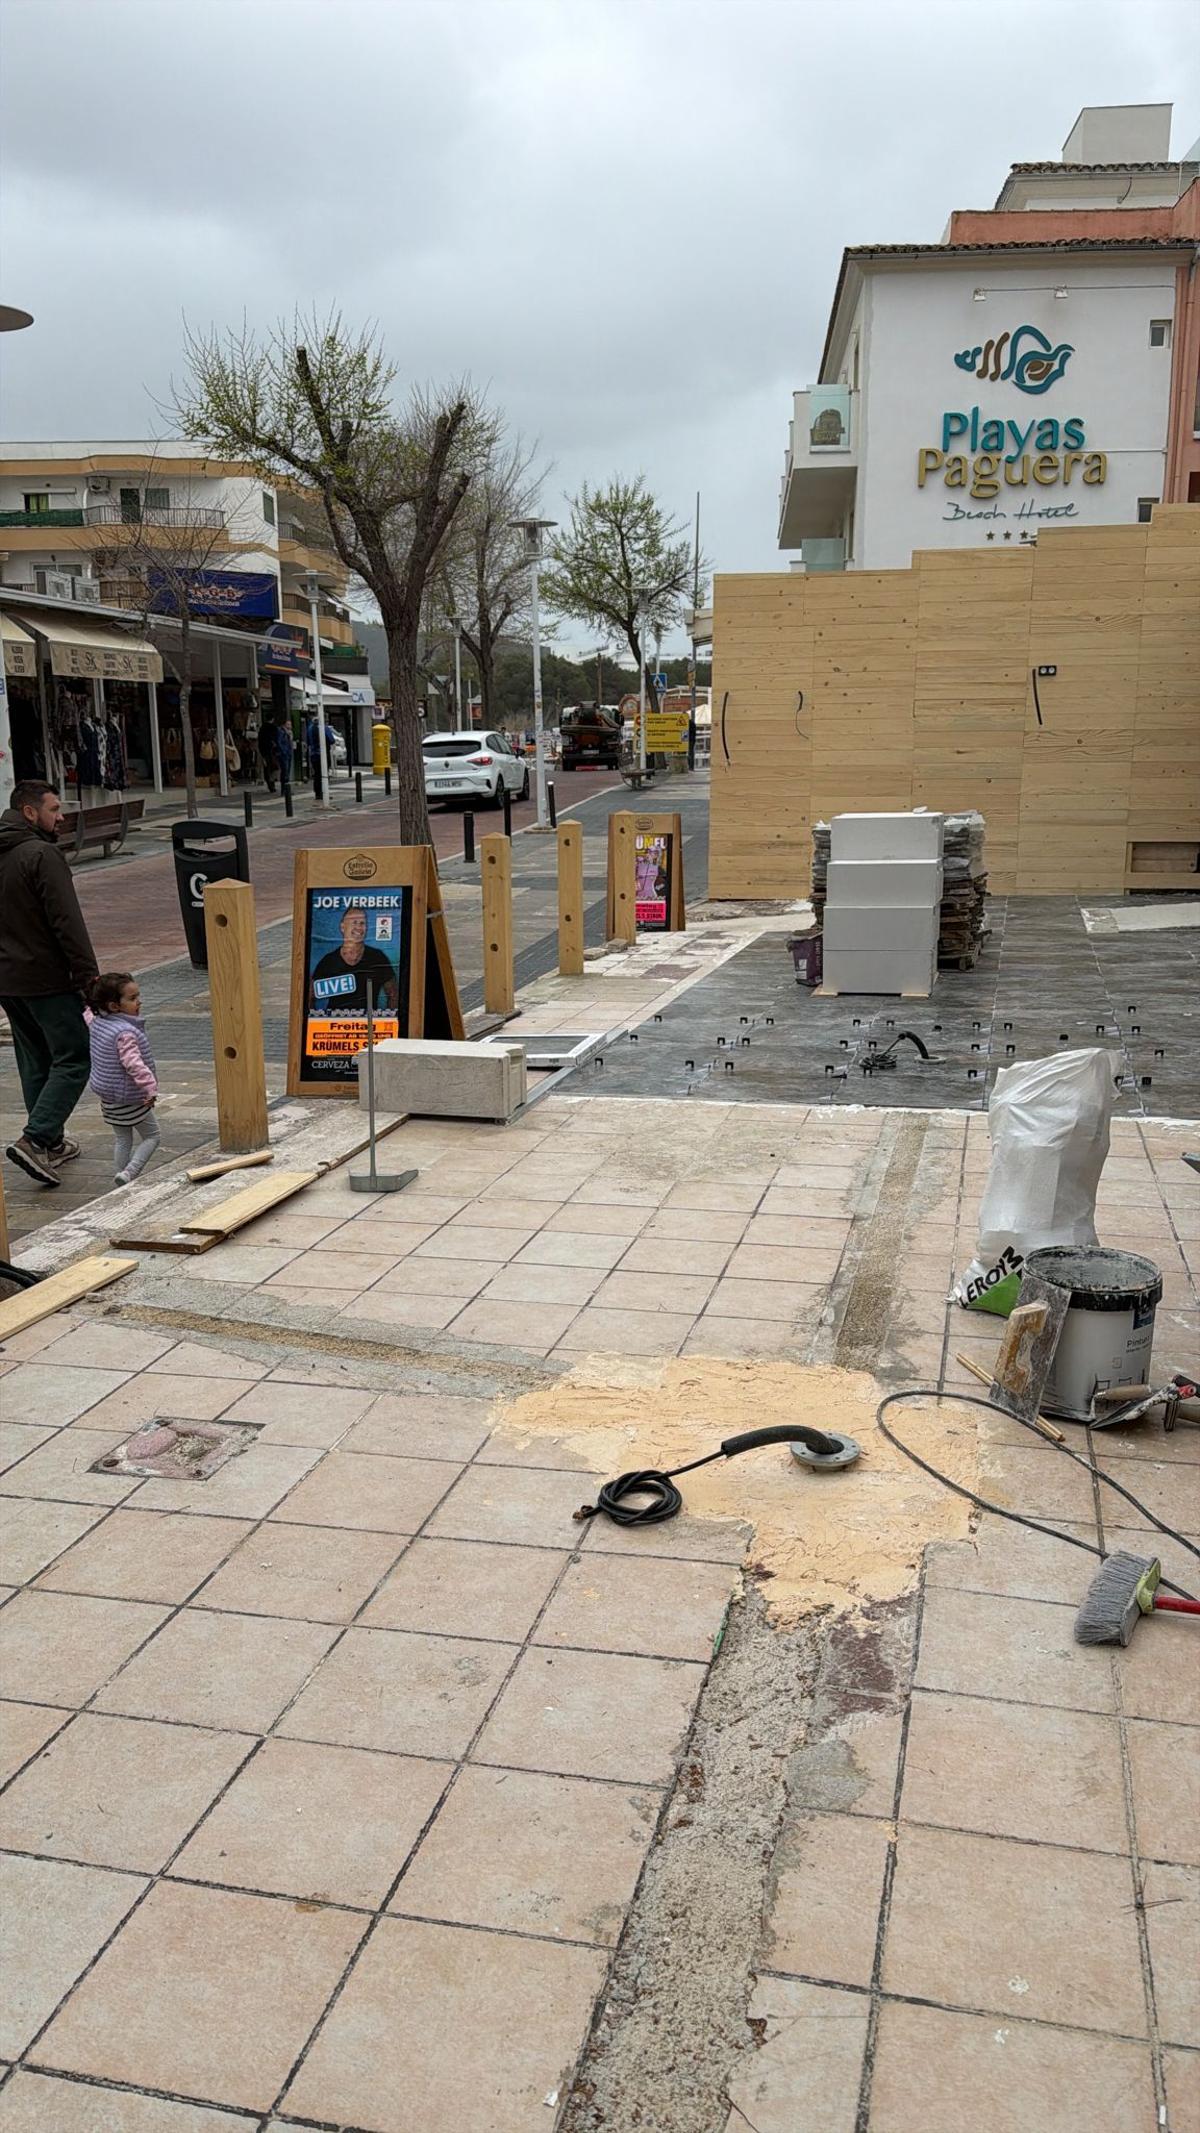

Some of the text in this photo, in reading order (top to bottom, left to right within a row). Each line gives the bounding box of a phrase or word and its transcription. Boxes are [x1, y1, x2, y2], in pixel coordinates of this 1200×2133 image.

[942, 406, 1086, 463] Playas
[918, 448, 1107, 499] Paguera
[942, 499, 1080, 521] Beach Hotel
[313, 895, 399, 908] JOE VERBEEK
[316, 976, 354, 996] LIVE!
[312, 1040, 359, 1051] KRÜMELS
[311, 1060, 350, 1069] CERVEZA
[959, 1257, 1008, 1309] LEROY
